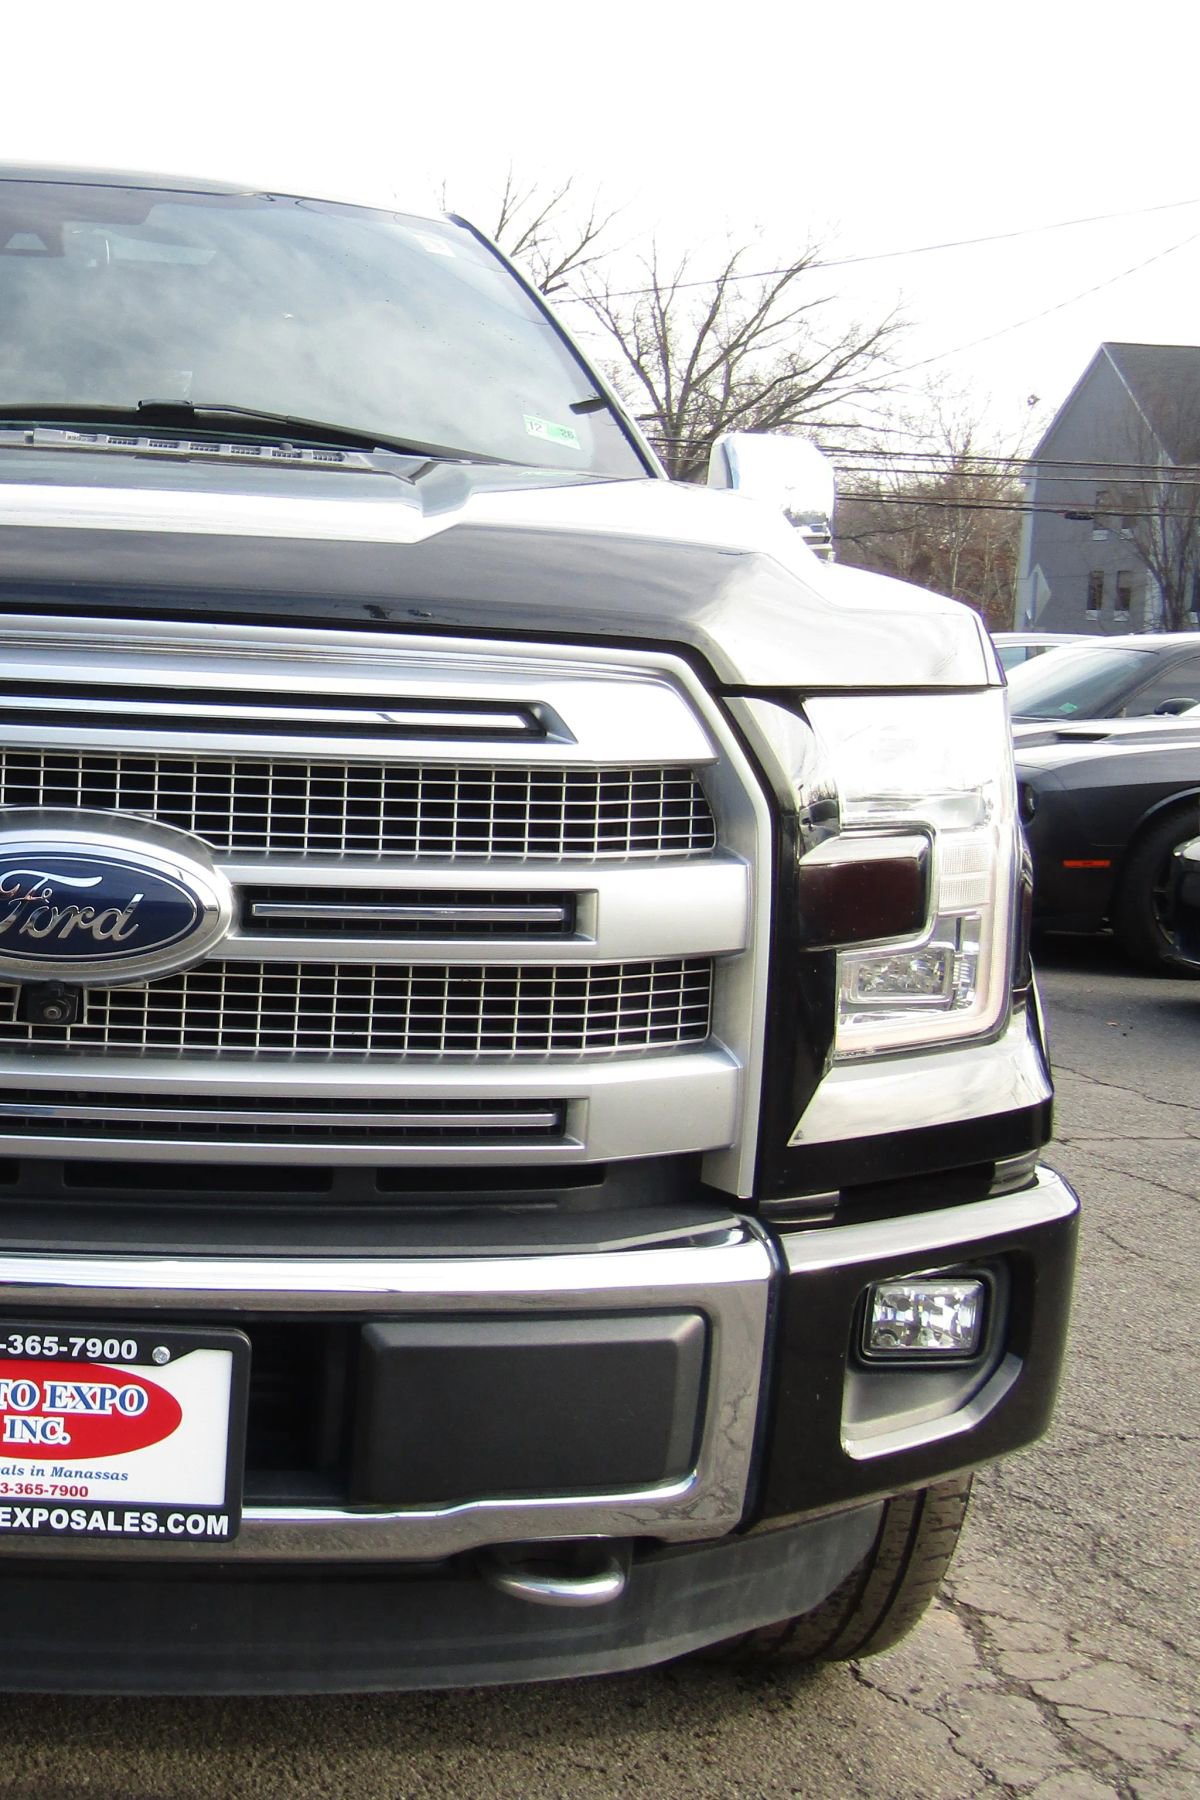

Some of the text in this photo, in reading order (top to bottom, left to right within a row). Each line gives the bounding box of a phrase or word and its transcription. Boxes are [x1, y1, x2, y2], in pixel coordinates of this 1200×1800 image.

[43, 1381, 149, 1416] EXPO
[3, 1415, 71, 1445] INC.
[29, 1464, 46, 1478] in
[51, 1467, 129, 1482] Manassas
